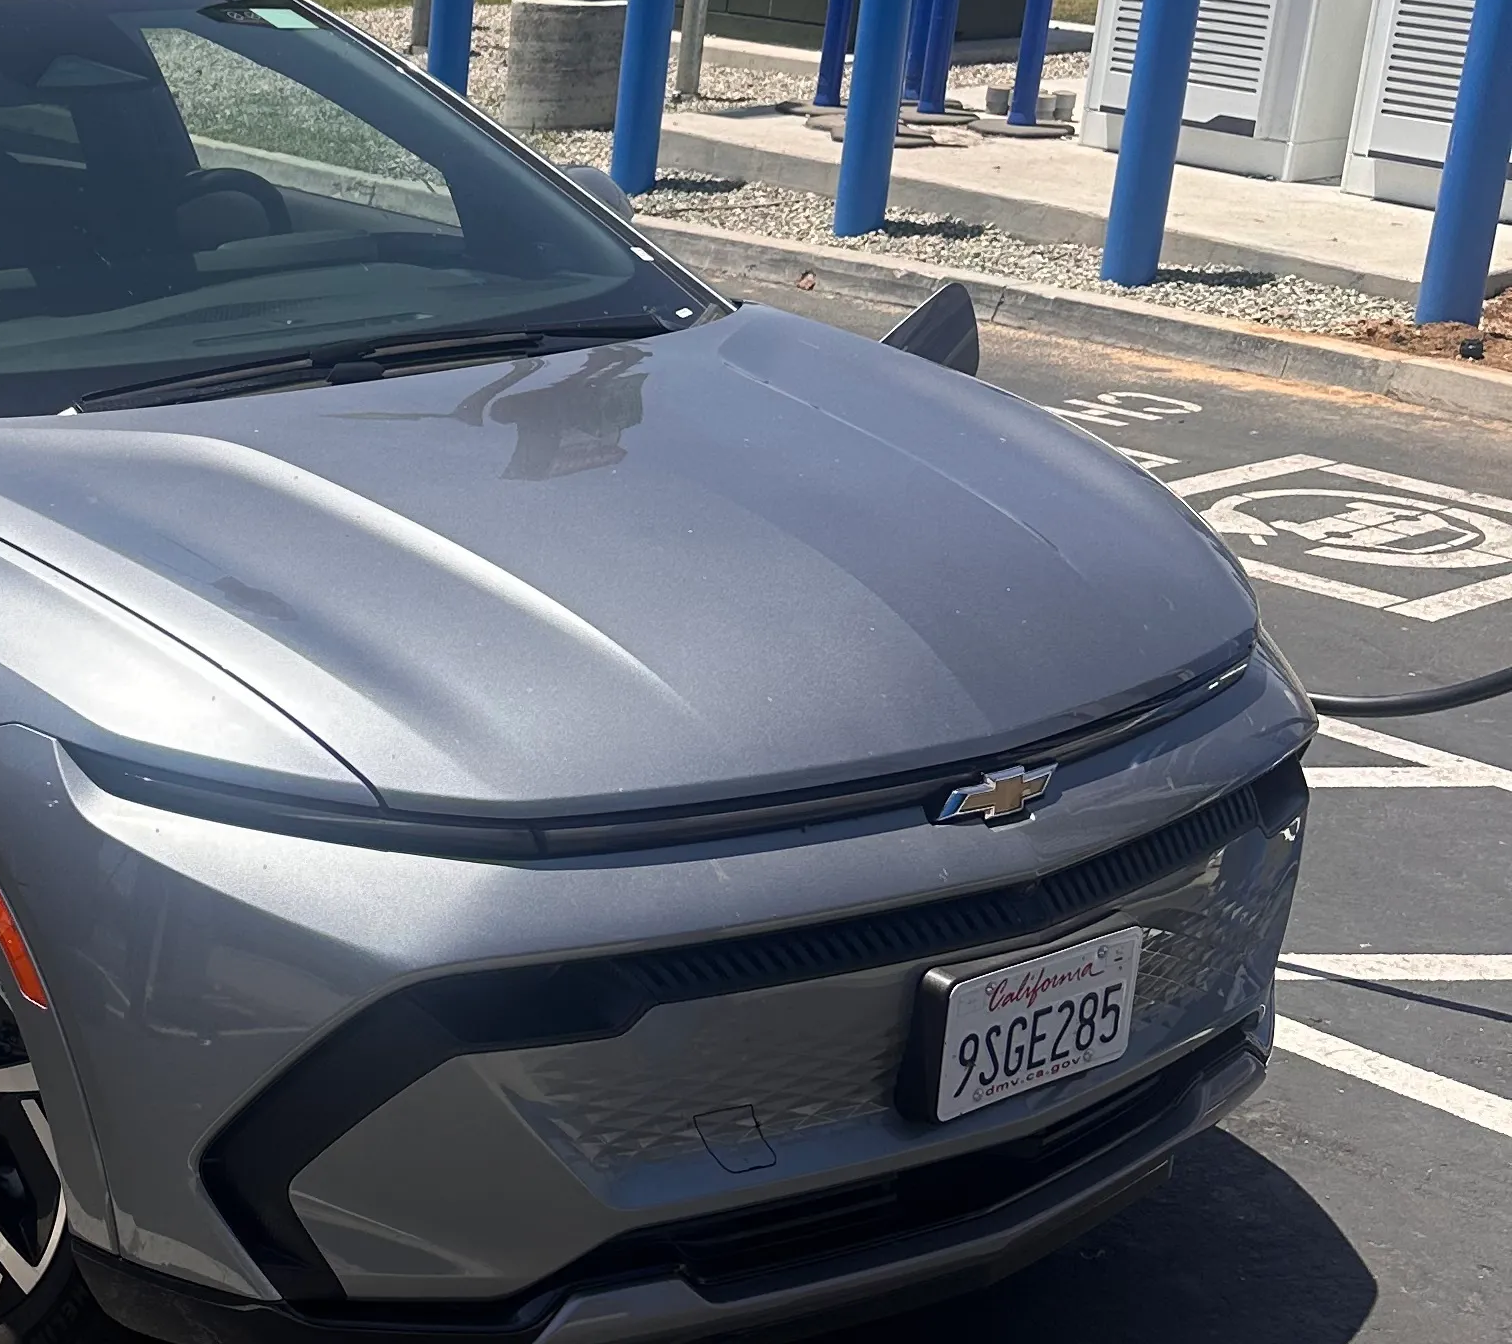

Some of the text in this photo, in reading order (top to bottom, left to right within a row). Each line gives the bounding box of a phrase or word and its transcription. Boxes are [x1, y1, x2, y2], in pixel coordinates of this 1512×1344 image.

[988, 961, 1105, 1012] California
[953, 982, 1123, 1098] 9SGE285
[985, 1055, 1080, 1097] dmv.ca.gov
